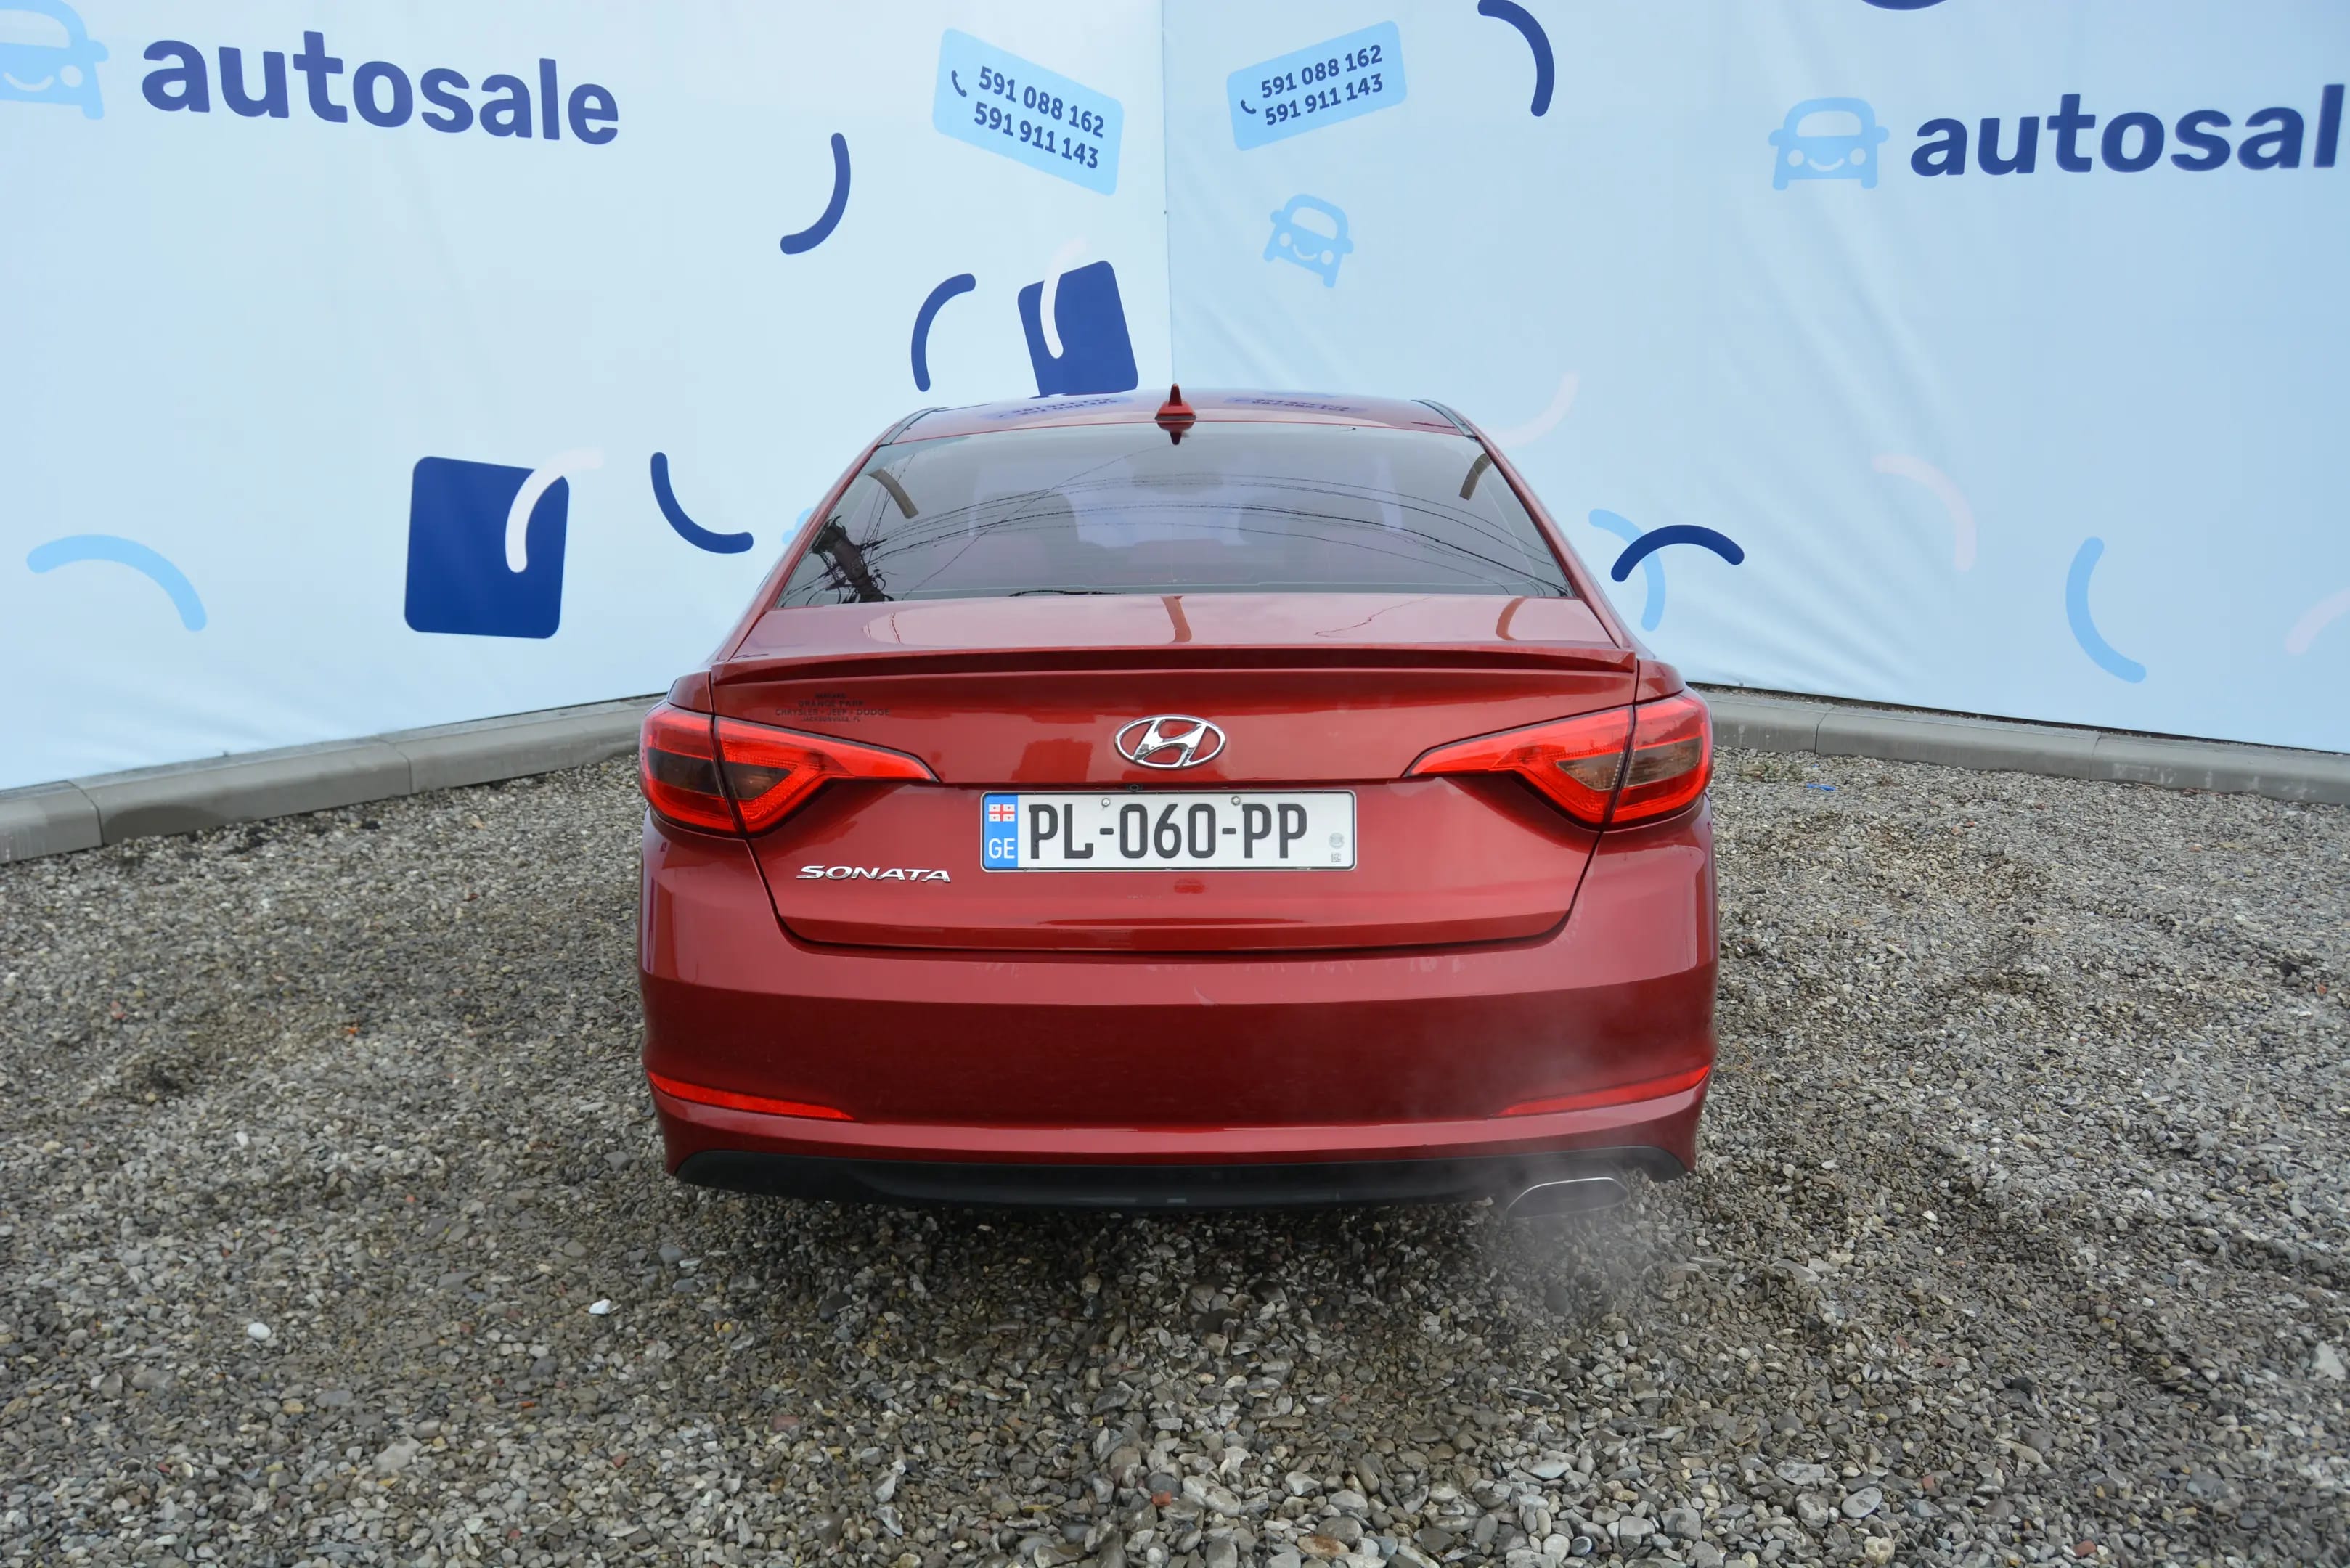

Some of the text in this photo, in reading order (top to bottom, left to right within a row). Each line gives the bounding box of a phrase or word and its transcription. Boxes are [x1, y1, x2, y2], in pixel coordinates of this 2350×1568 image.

[141, 30, 619, 146] autosale
[1260, 44, 1383, 99] 591 088 162
[1265, 73, 1383, 126] 591 911 143
[978, 65, 1104, 139] 591 088 162
[1909, 83, 2347, 177] autosal
[974, 101, 1098, 169] 591 911 143
[988, 838, 1016, 859] GE
[1028, 803, 1307, 859] PL-060-PP
[796, 865, 951, 883] SONATA
